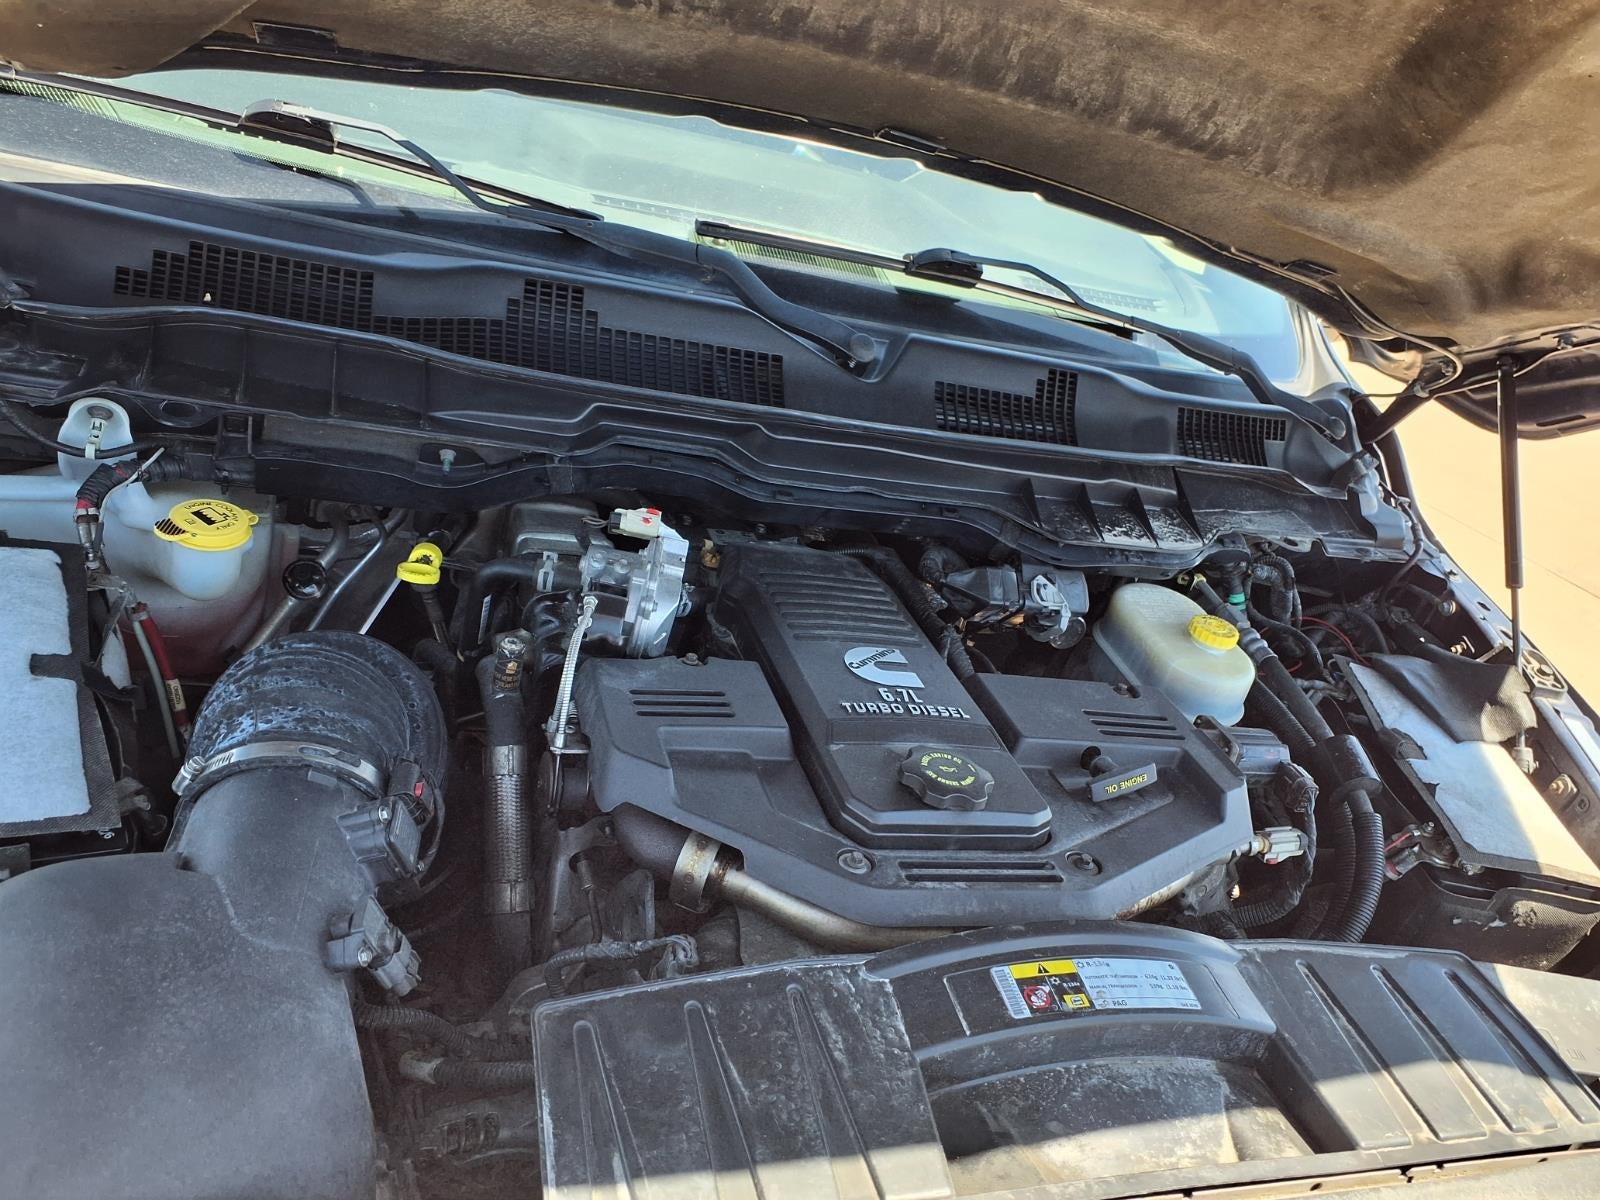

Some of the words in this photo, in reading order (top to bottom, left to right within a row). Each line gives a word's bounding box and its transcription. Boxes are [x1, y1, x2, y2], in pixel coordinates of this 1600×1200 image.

[849, 648, 896, 670] Cummins
[878, 687, 924, 703] 6.7L
[841, 702, 905, 715] TURBO
[908, 704, 971, 719] DIESEL
[1105, 784, 1118, 794] OIL
[1120, 773, 1148, 790] ENGINE
